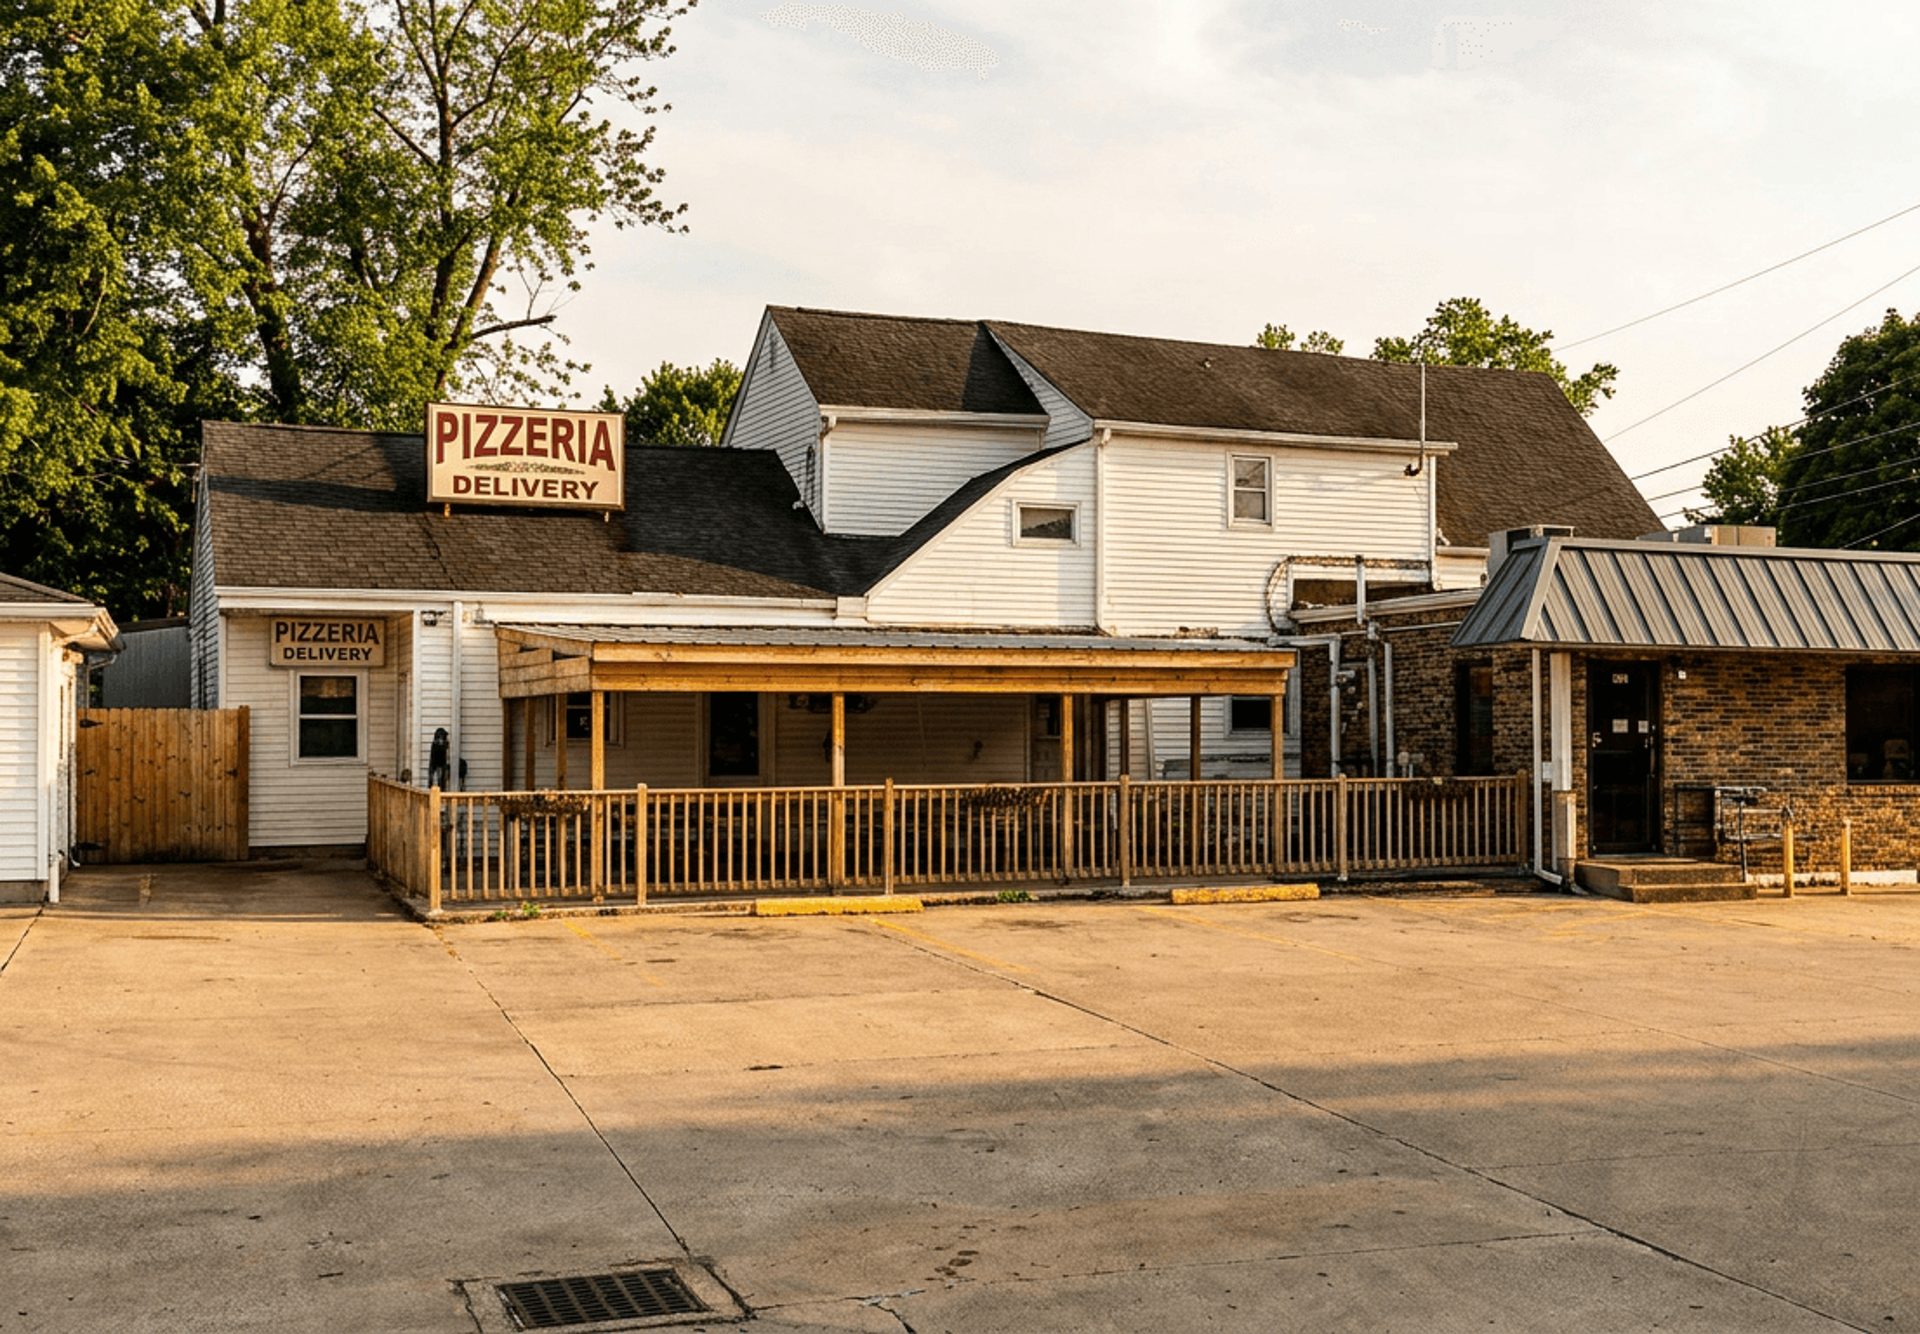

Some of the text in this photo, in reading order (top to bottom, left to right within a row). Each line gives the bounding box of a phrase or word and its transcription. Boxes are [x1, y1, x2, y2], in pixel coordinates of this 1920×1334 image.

[436, 411, 616, 471] PIZZERIA
[453, 475, 599, 499] DELIVERY
[276, 622, 379, 645] PIZZERIA
[284, 647, 372, 661] DELIVERY
